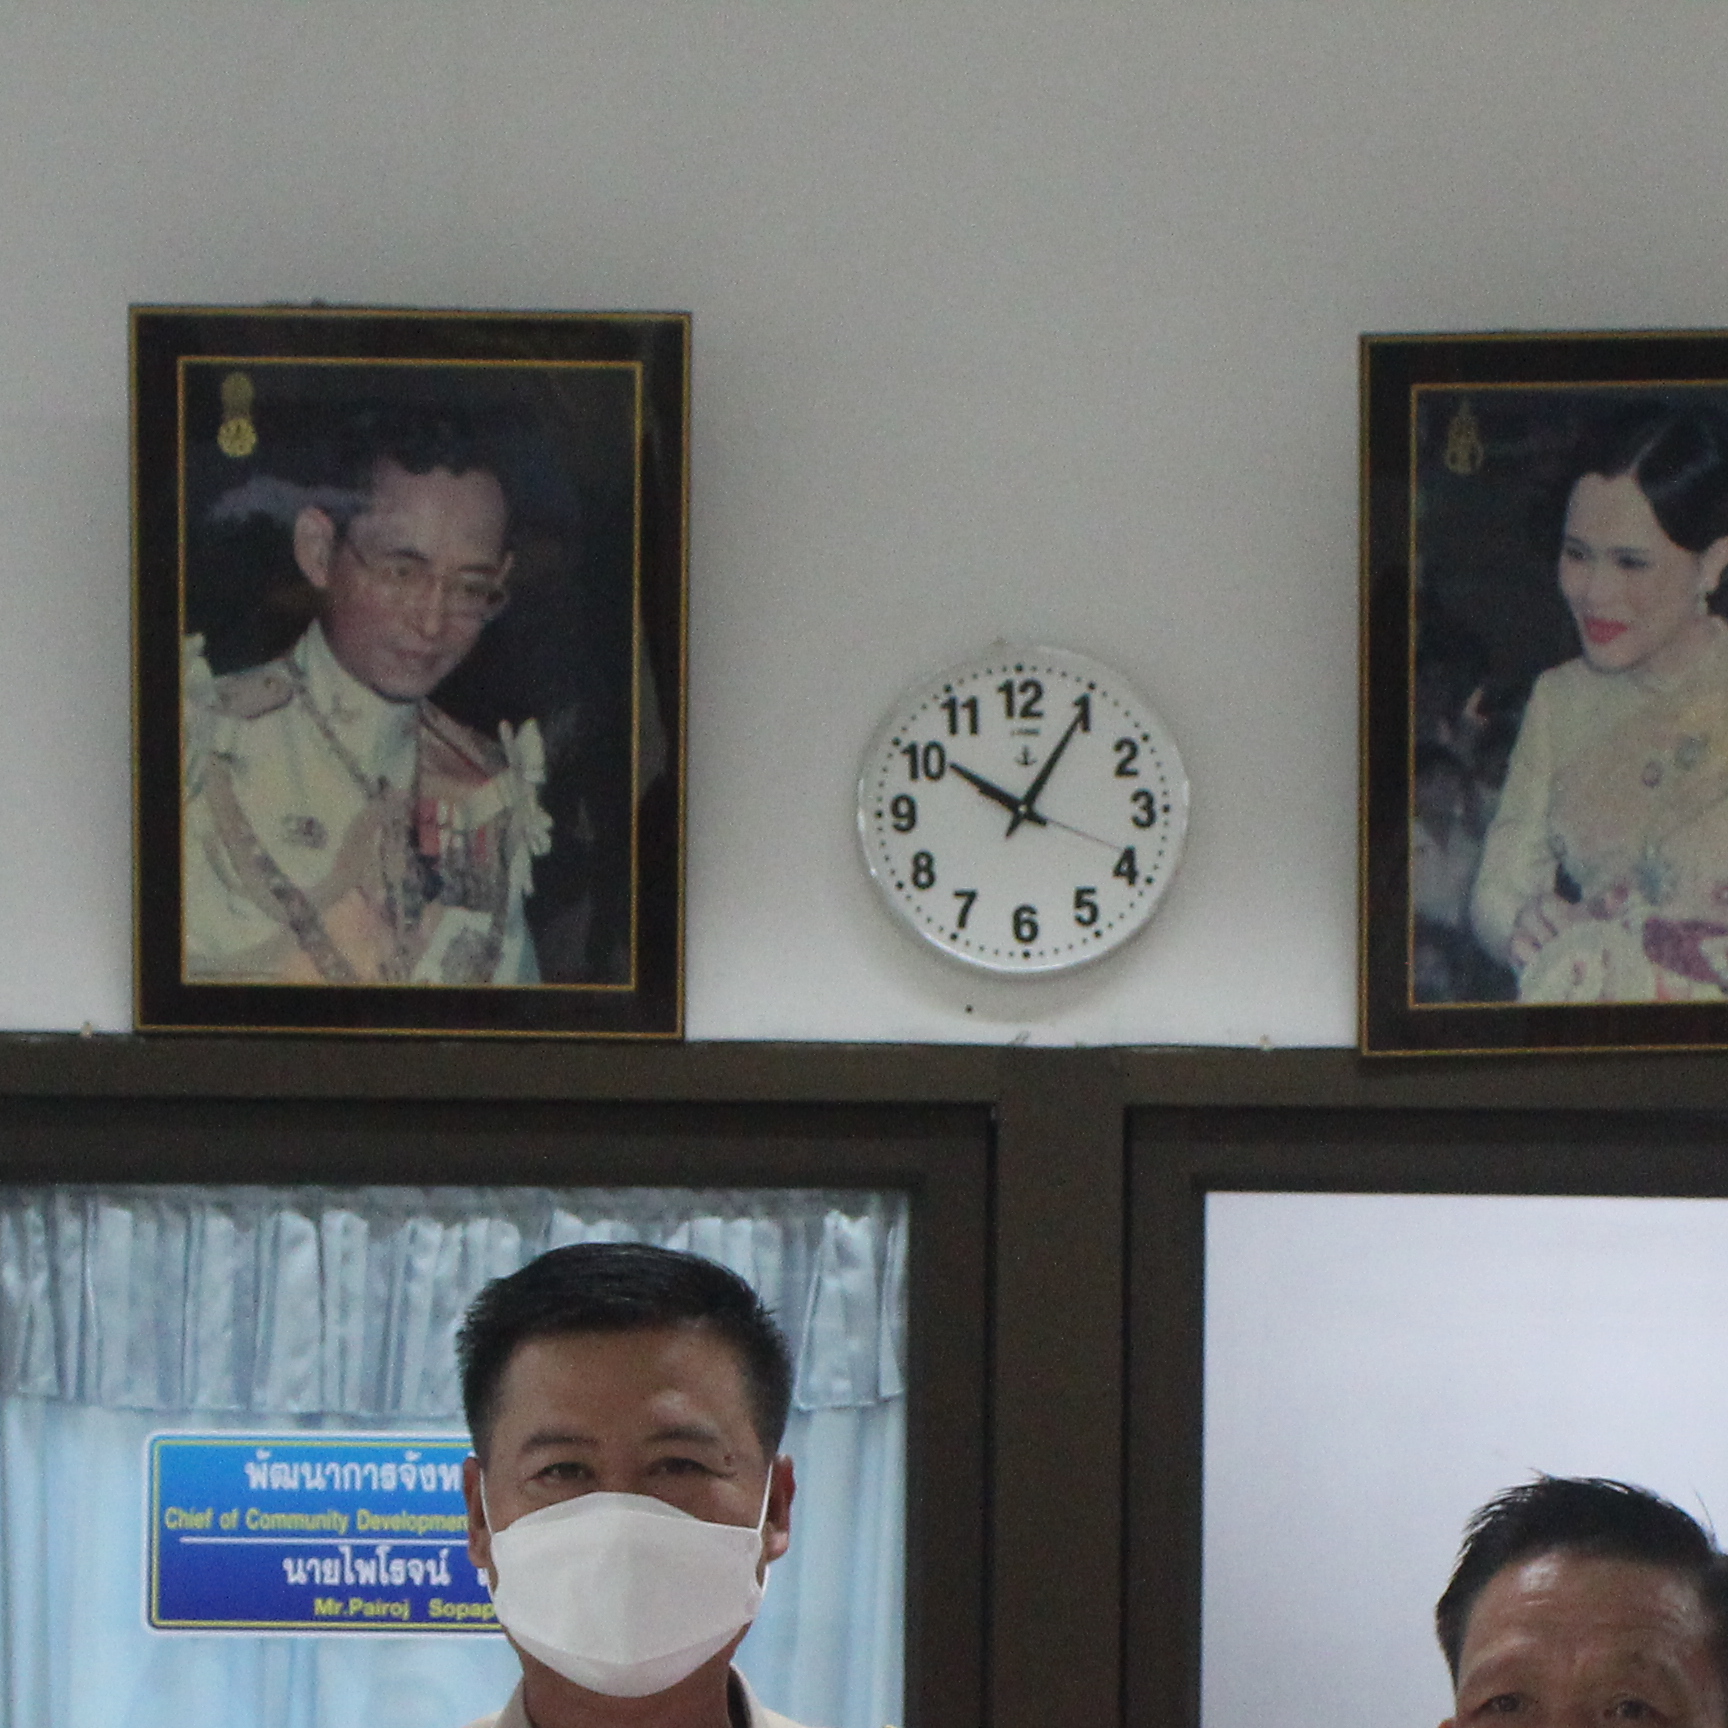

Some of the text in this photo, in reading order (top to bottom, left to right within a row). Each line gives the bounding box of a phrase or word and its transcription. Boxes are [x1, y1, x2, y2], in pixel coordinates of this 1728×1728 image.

[940, 696, 980, 735] 11
[997, 679, 1044, 719] 12
[1073, 693, 1092, 733] 1
[900, 740, 946, 781] 10
[1113, 737, 1139, 777] 2
[890, 794, 918, 832] 9
[1130, 789, 1156, 828] 3
[912, 851, 936, 890] 8
[1113, 845, 1138, 886] 4
[952, 889, 978, 929] 7
[1012, 904, 1039, 943] 6
[1073, 887, 1099, 926] 5
[164, 1506, 214, 1531] Chief
[220, 1507, 239, 1530] of
[245, 1507, 349, 1535] Community
[282, 1544, 451, 1587] นายไพโรจน์
